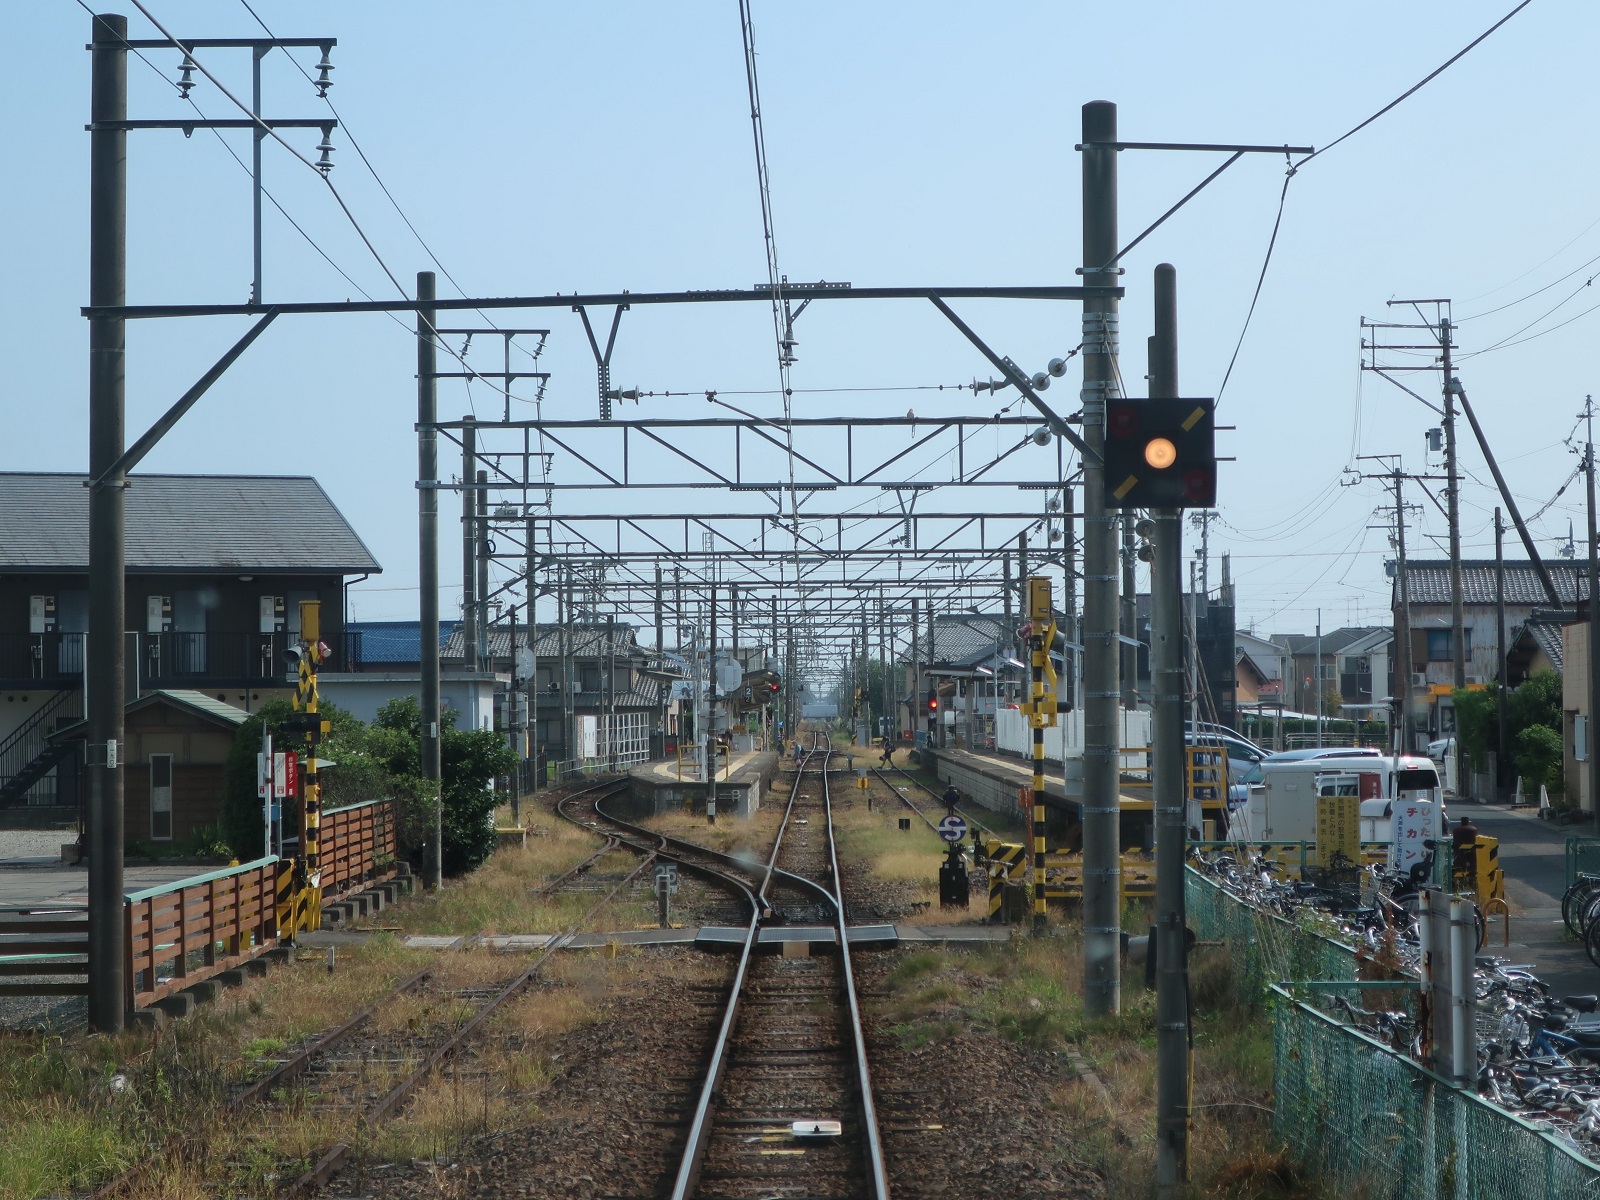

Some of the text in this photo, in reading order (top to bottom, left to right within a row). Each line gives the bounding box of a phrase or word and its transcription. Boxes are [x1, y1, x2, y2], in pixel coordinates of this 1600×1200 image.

[1405, 807, 1418, 860] チカン
[1420, 806, 1432, 860] ひったり
